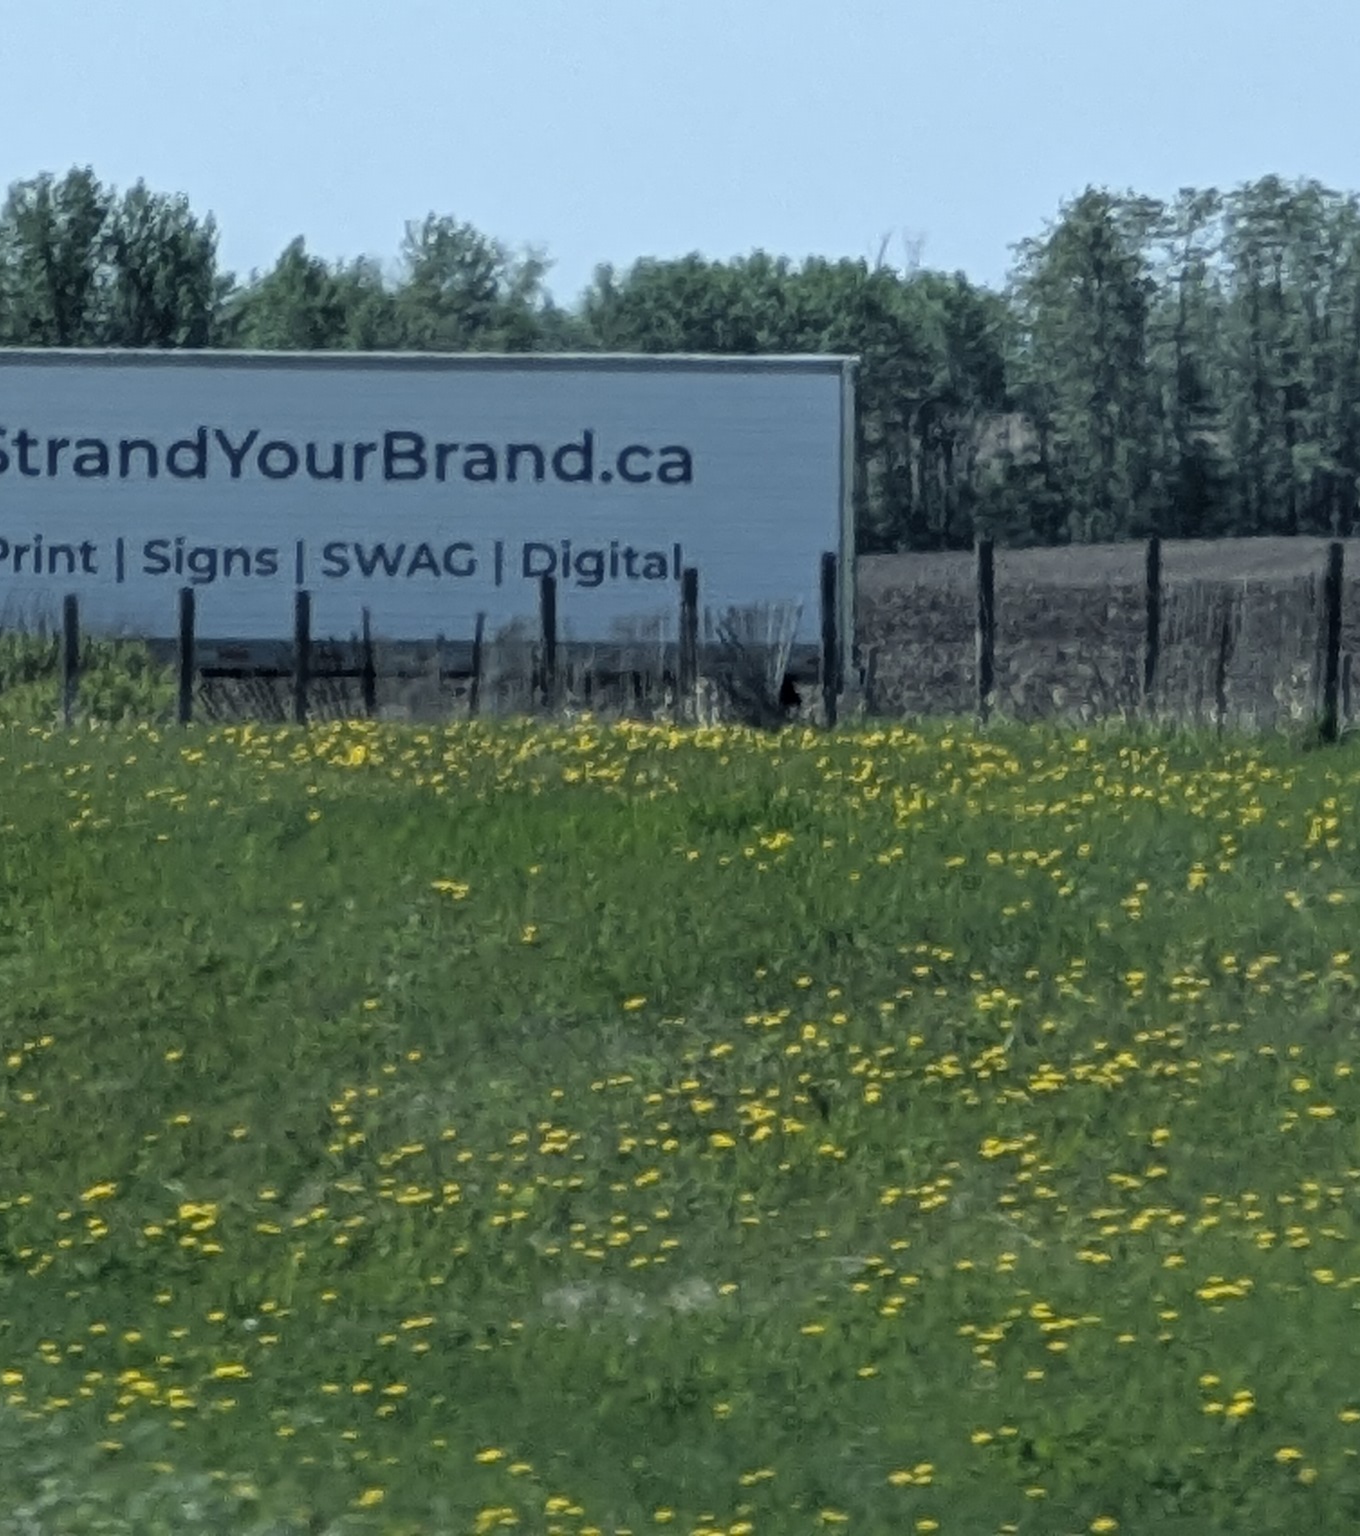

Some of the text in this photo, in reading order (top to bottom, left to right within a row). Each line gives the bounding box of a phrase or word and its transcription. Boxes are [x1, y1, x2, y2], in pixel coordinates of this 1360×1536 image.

[142, 535, 279, 585] Signs
[321, 541, 477, 578] SWAG
[522, 539, 681, 588] Digital
